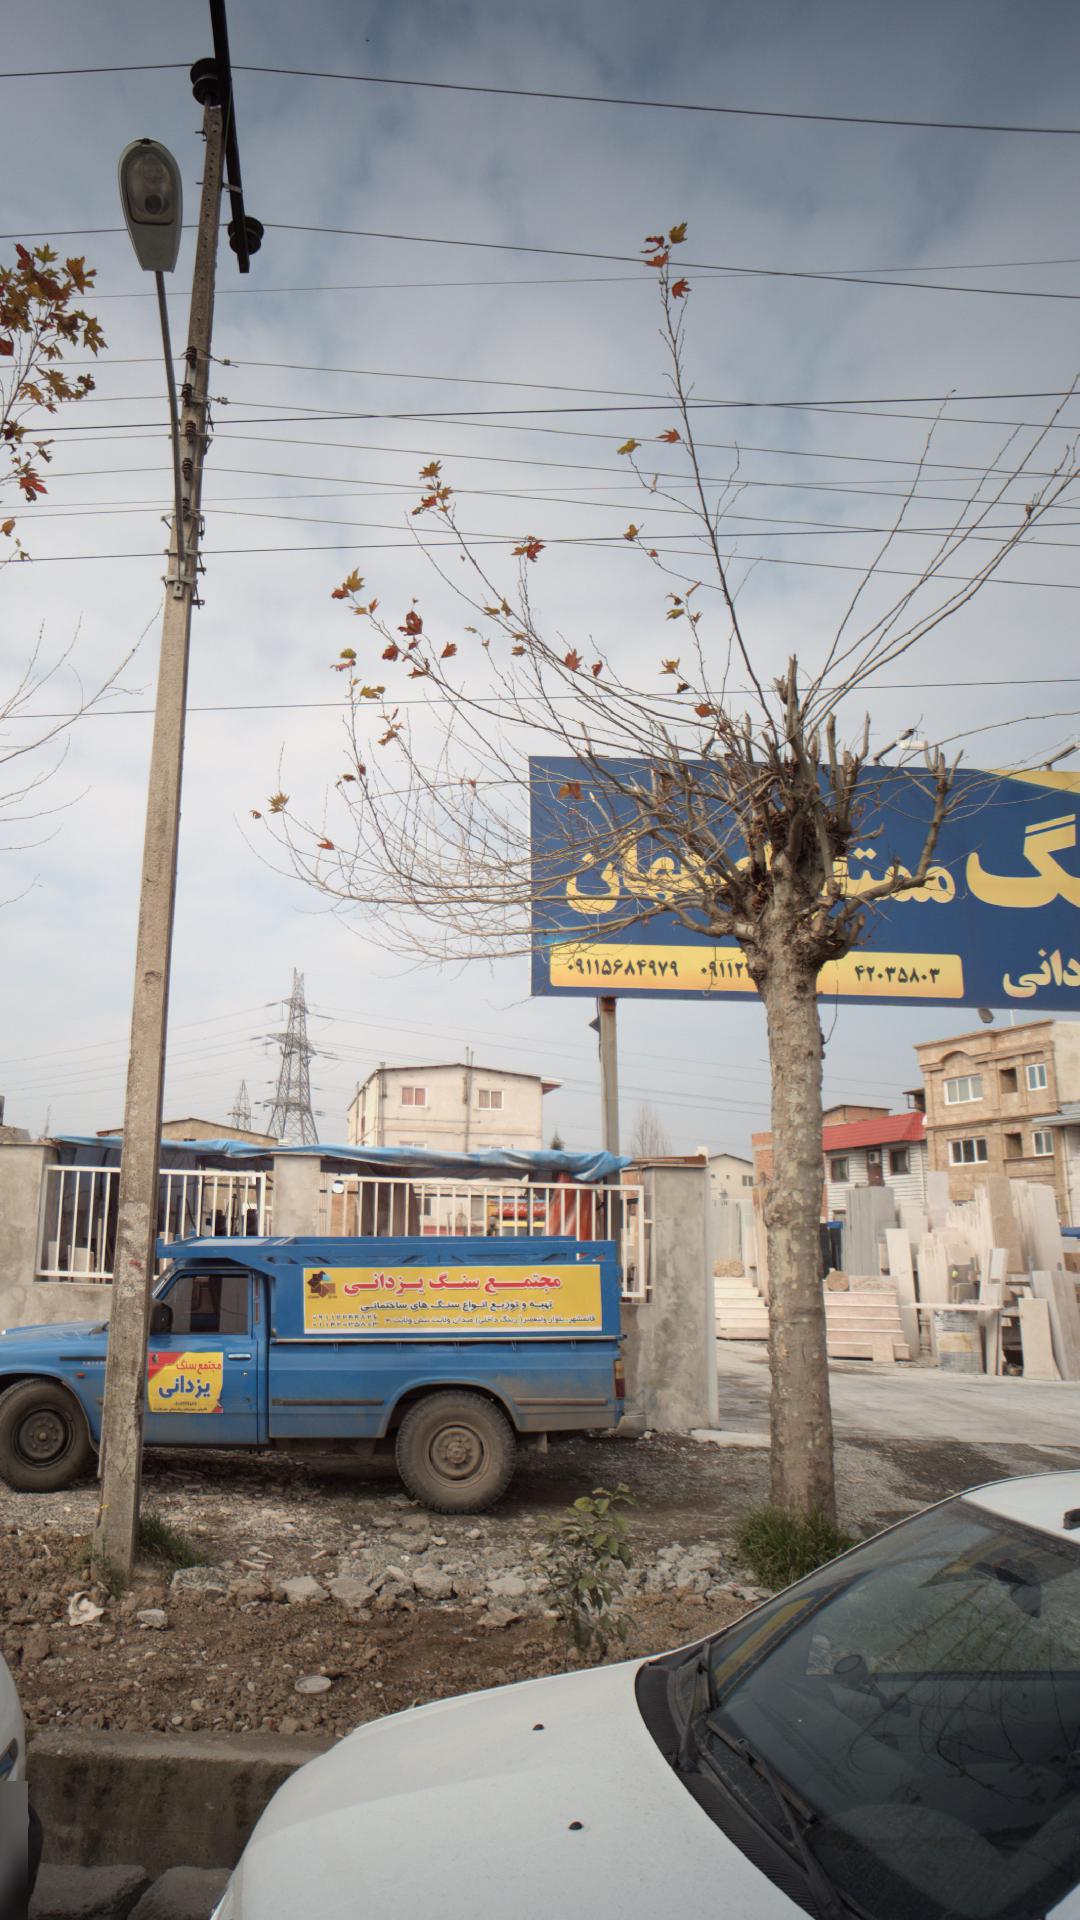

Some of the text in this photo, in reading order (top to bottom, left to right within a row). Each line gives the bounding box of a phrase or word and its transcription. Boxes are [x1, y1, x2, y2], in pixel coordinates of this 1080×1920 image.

[567, 957, 679, 977] ۰۹۱۱۵۶۸۴۹۷۹
[344, 1271, 561, 1295] مجتمع سنگ یزدانی
[360, 1299, 553, 1312] تهیه و توزیع انواع سنگ های ساختمانی
[176, 1360, 221, 1374] مجتمع سنگ
[158, 1375, 210, 1398] یزدانی
